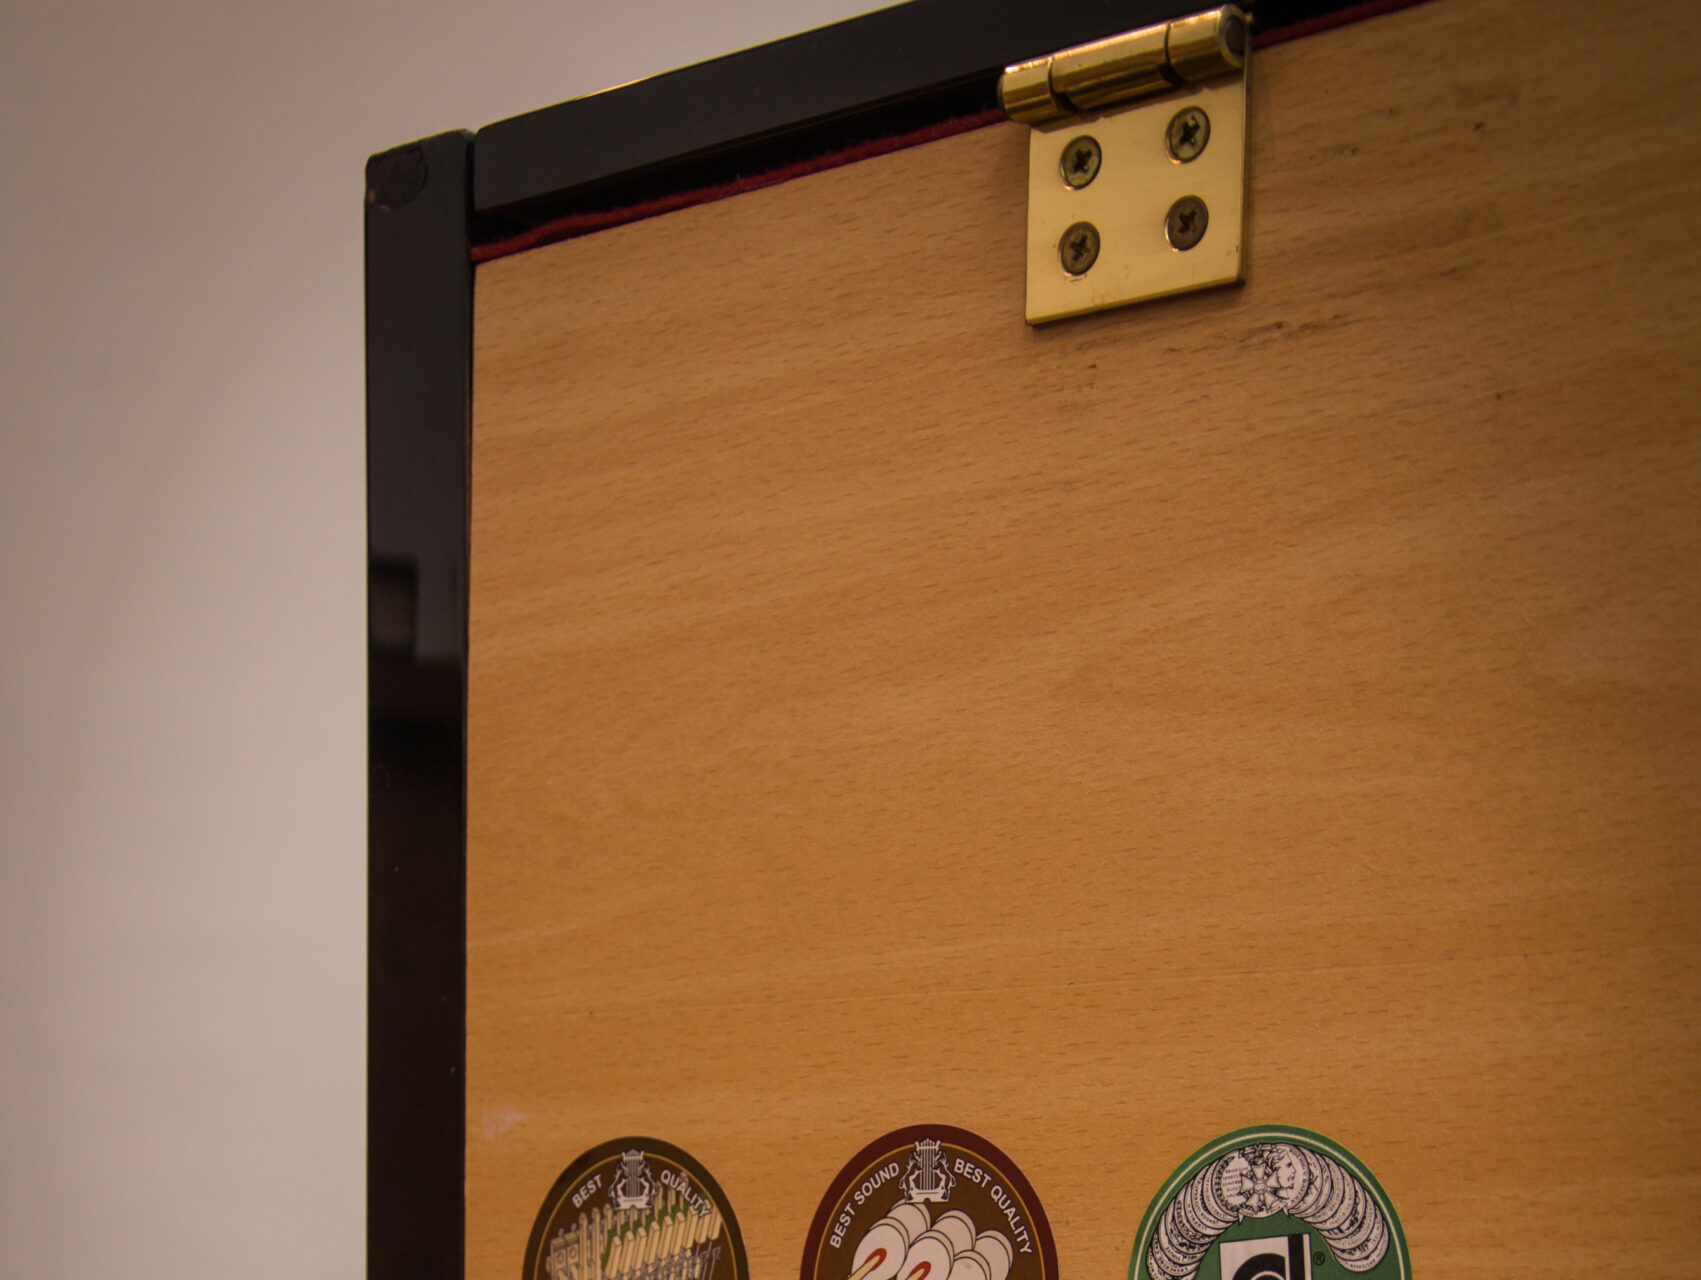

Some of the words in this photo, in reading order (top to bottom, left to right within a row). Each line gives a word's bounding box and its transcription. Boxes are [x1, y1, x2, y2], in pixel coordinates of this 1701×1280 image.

[572, 1174, 602, 1208] BEST
[660, 1169, 709, 1218] QUALITY
[829, 1203, 855, 1249] BEST
[854, 1162, 900, 1205] SOUND
[953, 1158, 992, 1189] BEST
[990, 1185, 1032, 1254] QUALITY
